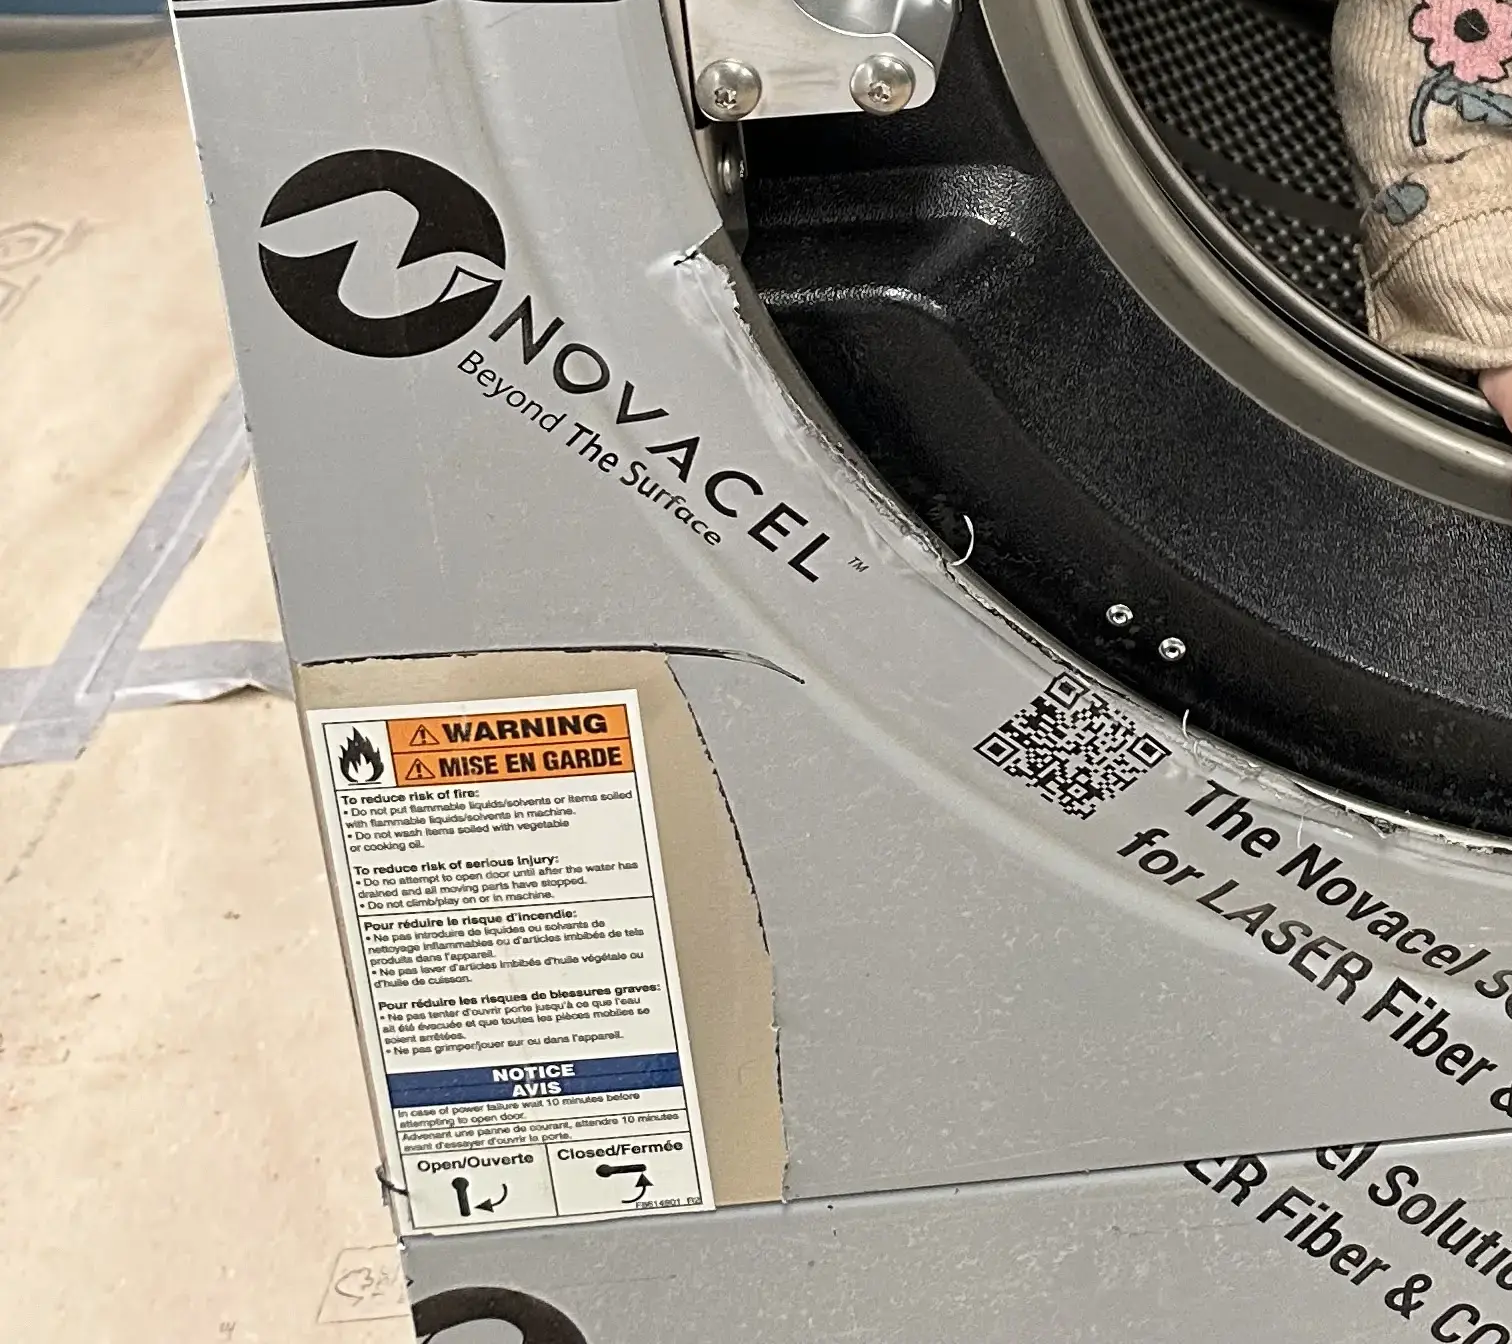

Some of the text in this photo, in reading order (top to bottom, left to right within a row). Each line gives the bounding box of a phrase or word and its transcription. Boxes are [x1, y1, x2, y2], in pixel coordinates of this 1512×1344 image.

[457, 349, 723, 548] Beyond The Surface
[488, 294, 831, 584] NOVACEL
[441, 713, 609, 744] WARNING
[439, 745, 622, 779] MISE EN GARDE
[342, 788, 480, 805] To reduce risk of fire:
[350, 807, 367, 816] Do
[369, 806, 388, 816] not
[389, 805, 408, 816] put
[408, 801, 466, 813] flammable
[553, 796, 566, 804] or
[567, 794, 598, 803] items
[599, 789, 633, 801] soiled
[344, 819, 368, 829] with
[369, 815, 426, 827] flammable
[513, 809, 524, 818] in
[526, 806, 576, 818] machine.
[354, 818, 569, 840] Do not wash items soiled with vegetable
[349, 839, 425, 852] or cooking oil.
[354, 854, 559, 876] To reduce risk of serious injury:
[362, 877, 380, 887] Do
[398, 873, 440, 884] attempt
[441, 873, 453, 882] to
[454, 872, 483, 882] open
[484, 869, 510, 879] door
[512, 866, 535, 877] until
[537, 865, 564, 875] after
[564, 864, 583, 873] the
[584, 863, 615, 872] water
[617, 861, 638, 870] has
[357, 875, 588, 898] drained and all moving parts have stopped.
[1182, 777, 1283, 861] The
[1277, 842, 1491, 979] Novacel
[366, 900, 384, 910] Do
[385, 899, 404, 908] not
[461, 896, 476, 904] on
[477, 895, 490, 903] or
[492, 892, 503, 902] in
[504, 890, 555, 901] machine.
[363, 908, 577, 931] Pour réduire le risque d'incendie:
[1115, 825, 1206, 887] for
[1196, 877, 1374, 1007] LASER
[1360, 975, 1499, 1092] Fiber
[377, 983, 661, 1011] Pour réduire les risques de blessures graves:
[492, 1062, 576, 1084] NOTICE
[512, 1080, 562, 1099] AVIS
[557, 1139, 684, 1162] Closed/Fermée
[417, 1152, 535, 1174] Open/Ouverte
[1255, 1183, 1393, 1289] Fiber
[1383, 1271, 1435, 1322] &
